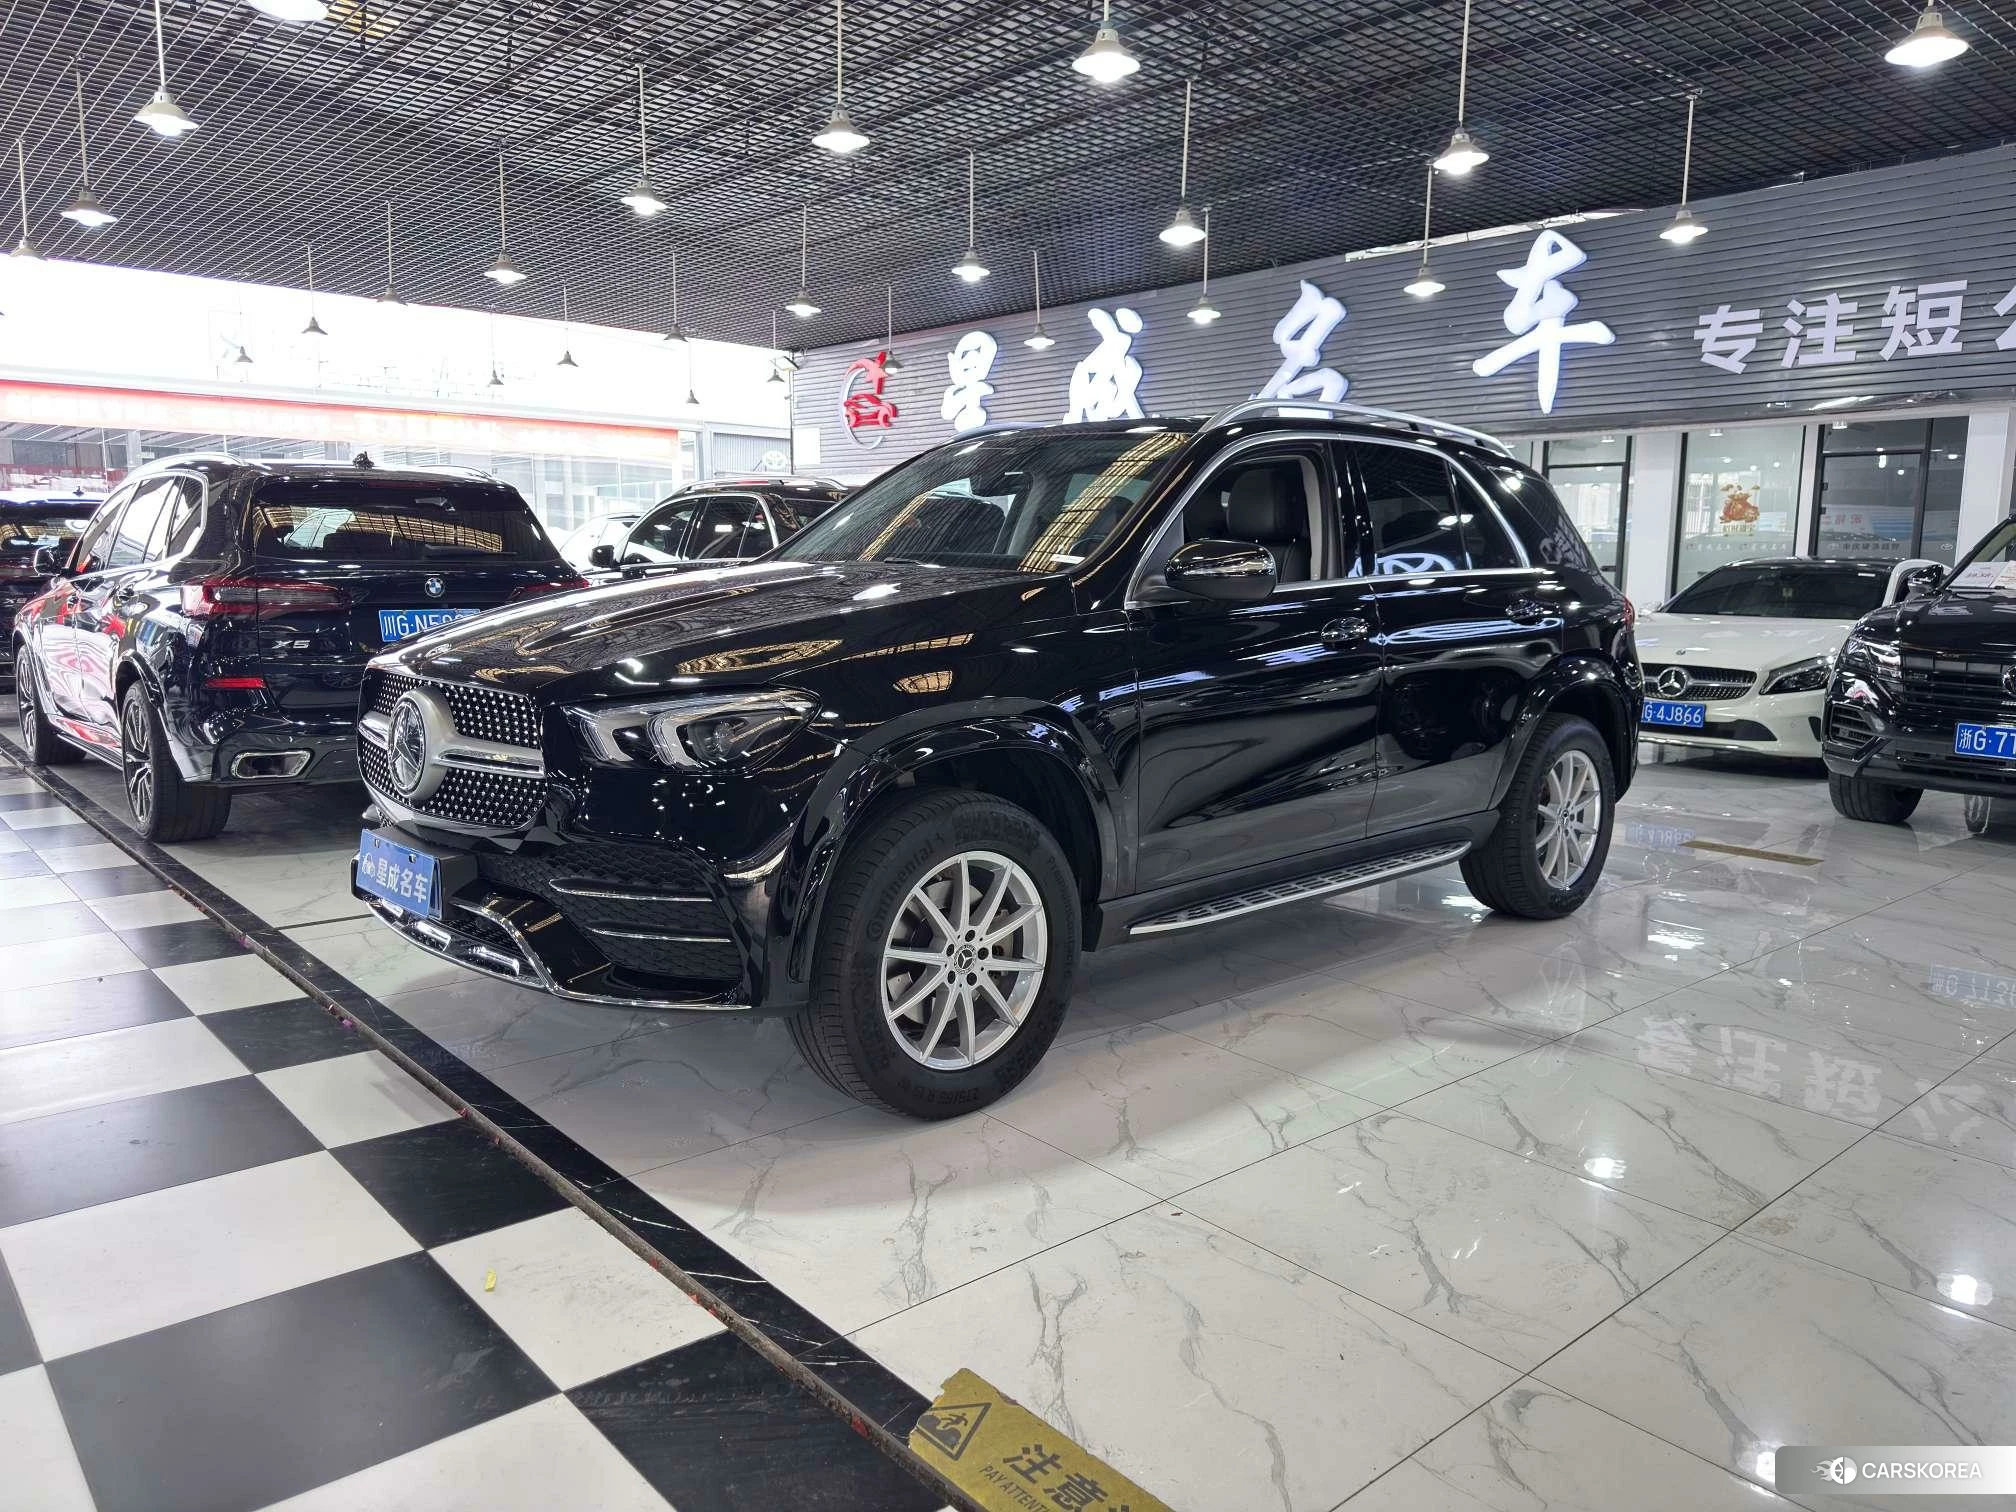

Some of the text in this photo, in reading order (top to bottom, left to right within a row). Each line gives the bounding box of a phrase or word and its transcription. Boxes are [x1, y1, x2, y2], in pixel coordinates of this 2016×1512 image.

[271, 639, 311, 649] X5
[1642, 704, 1702, 723] G·4J866
[1002, 1443, 1130, 1512] 注意
[1000, 1481, 1050, 1512] ATTENT
